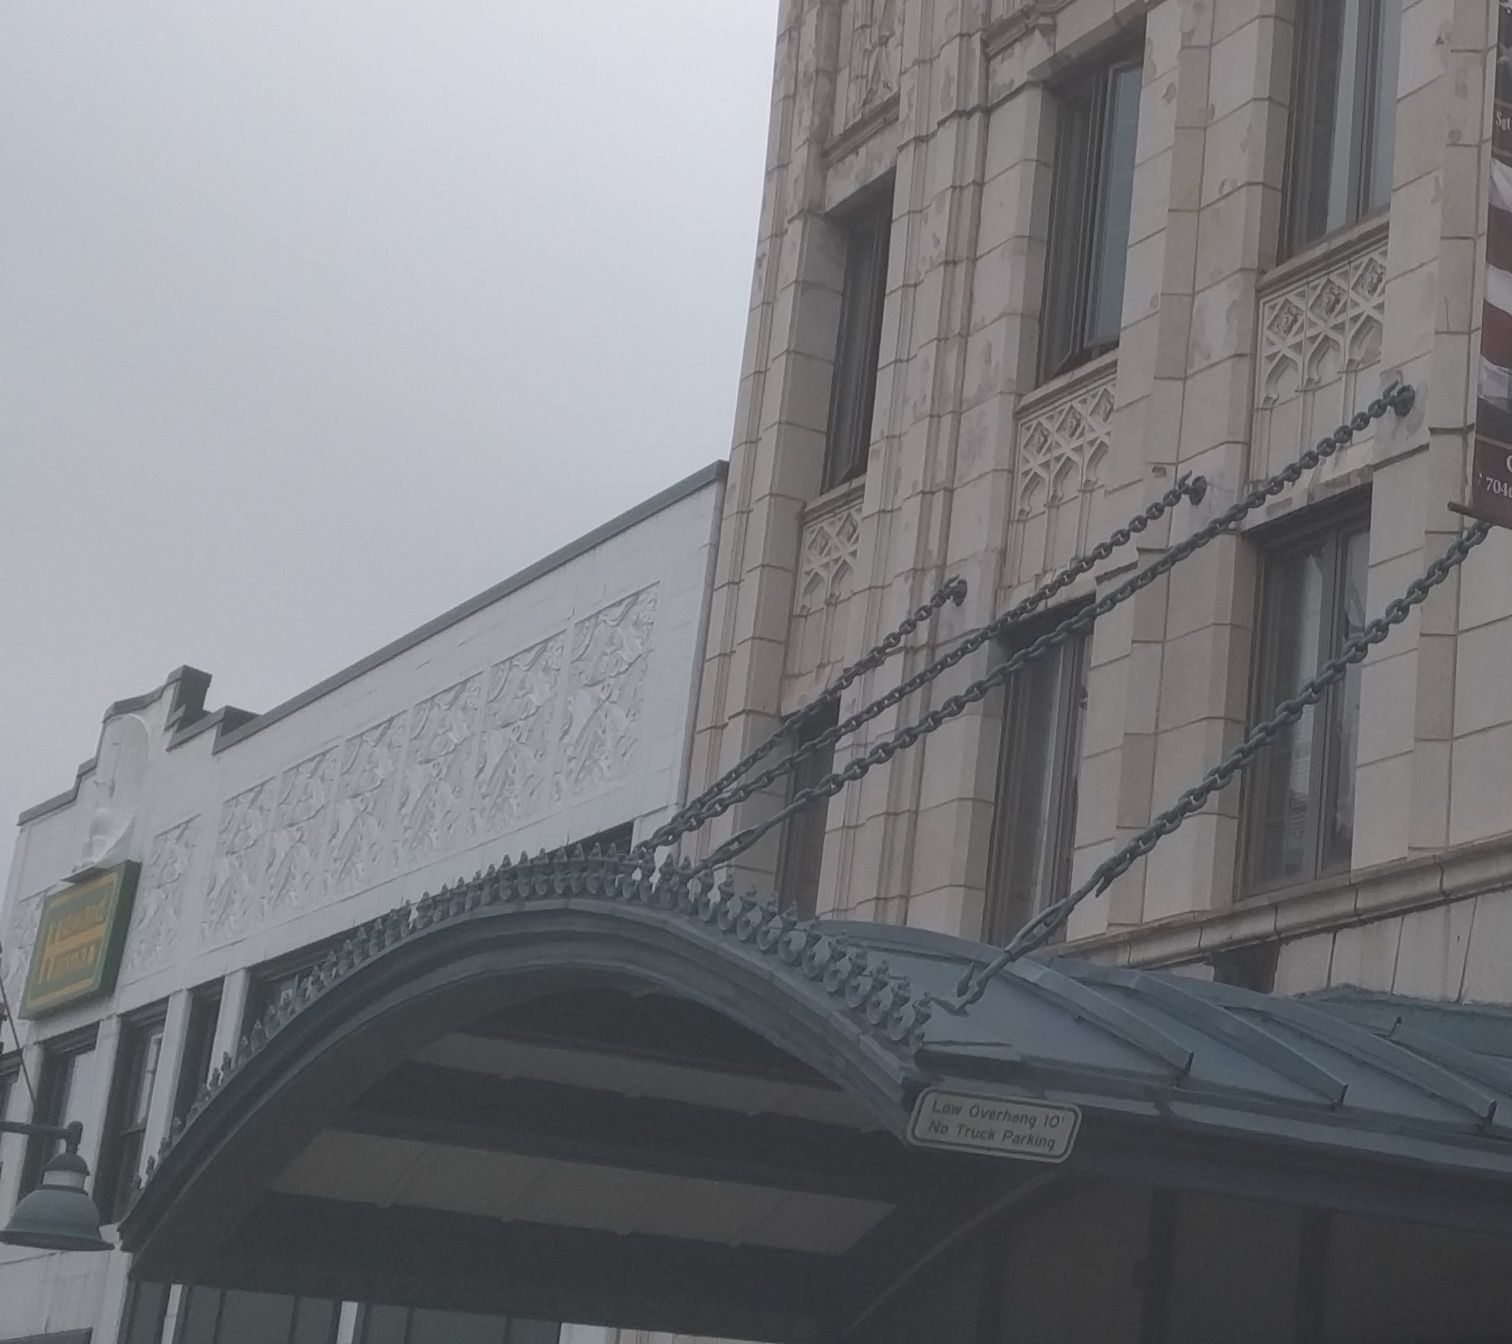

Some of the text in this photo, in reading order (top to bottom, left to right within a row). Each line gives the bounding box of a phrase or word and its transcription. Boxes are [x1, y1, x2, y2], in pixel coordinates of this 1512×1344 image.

[932, 1100, 962, 1117] Low
[968, 1104, 1038, 1129] Overhang
[928, 1120, 1056, 1151] No Truck Parking
